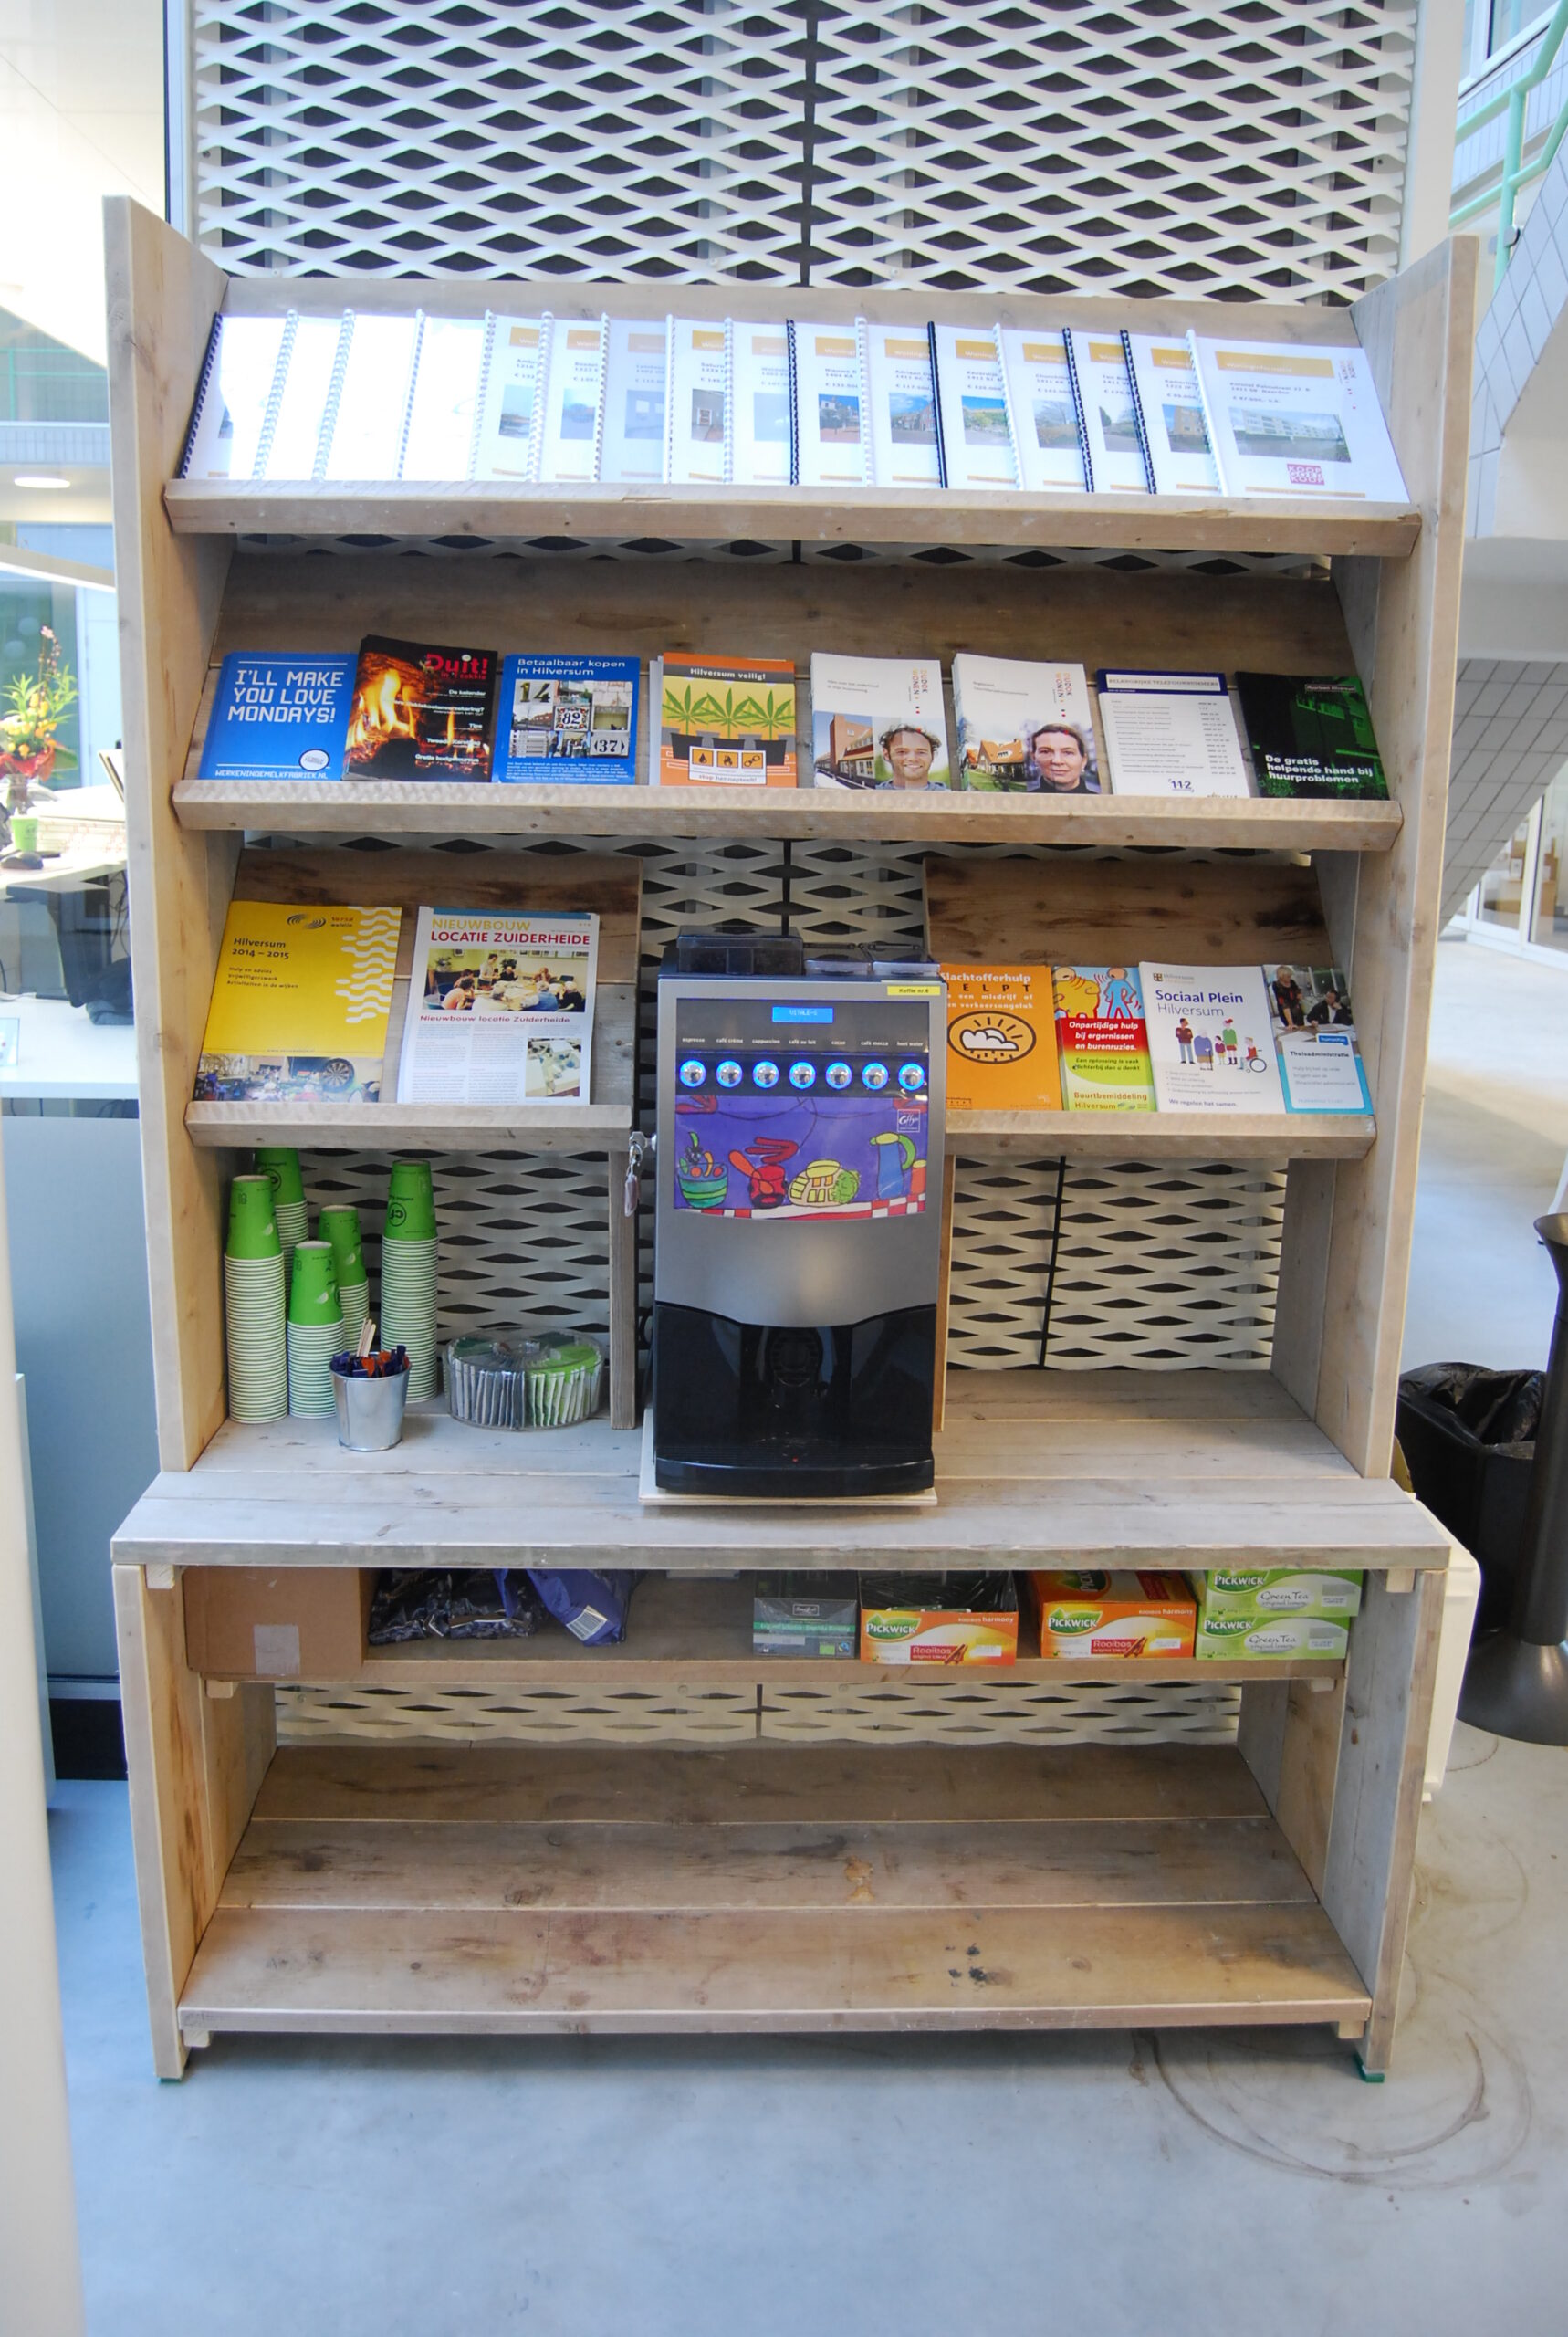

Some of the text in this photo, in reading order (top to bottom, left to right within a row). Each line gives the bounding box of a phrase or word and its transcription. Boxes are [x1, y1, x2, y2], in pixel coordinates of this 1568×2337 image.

[426, 653, 488, 675] Duit!
[517, 658, 626, 668] Betaalbaar kopen
[532, 667, 594, 676] Hilversum
[690, 667, 767, 681] Hilversum veilig!
[235, 669, 345, 686] I'LL MAKE
[234, 687, 336, 705] YOU LOVE
[520, 682, 551, 703] 14
[228, 706, 336, 723] MONDAYS!
[562, 713, 580, 725] 82
[1265, 754, 1320, 767] De gratis
[1267, 762, 1374, 777] helpende hand bij
[1269, 771, 1360, 783] huurproblemen
[1170, 781, 1192, 790] 112
[432, 918, 531, 931] NIEUWBOUW
[233, 937, 287, 948] Hilversum
[431, 931, 591, 946] LOCATIE ZUIDERHEIDE
[232, 948, 256, 958] 2014
[267, 950, 290, 960] 2015
[941, 972, 1031, 985] Slachtofferhulp
[1155, 990, 1244, 1003] Sociaal Plein
[960, 1001, 1033, 1010] verkeersongeluk
[1157, 1002, 1224, 1016] Hilversum
[1069, 1021, 1139, 1031] Onpartijdige hulp
[1075, 1031, 1134, 1041] bij ergernissen
[1073, 1092, 1148, 1102] Buurtbemiddeling
[1074, 1102, 1117, 1110] Hilversum
[1214, 1576, 1265, 1586] PICKWICK
[1260, 1590, 1291, 1600] Green
[1292, 1590, 1309, 1600] Tea
[1162, 1608, 1194, 1616] harmony
[982, 1616, 1014, 1624] harmony
[1048, 1617, 1098, 1628] PICKWICK
[1203, 1619, 1252, 1630] PICKWICK
[866, 1623, 916, 1634] PICKWICK
[1093, 1640, 1132, 1648] Rooibos
[1249, 1634, 1296, 1643] Green Tea
